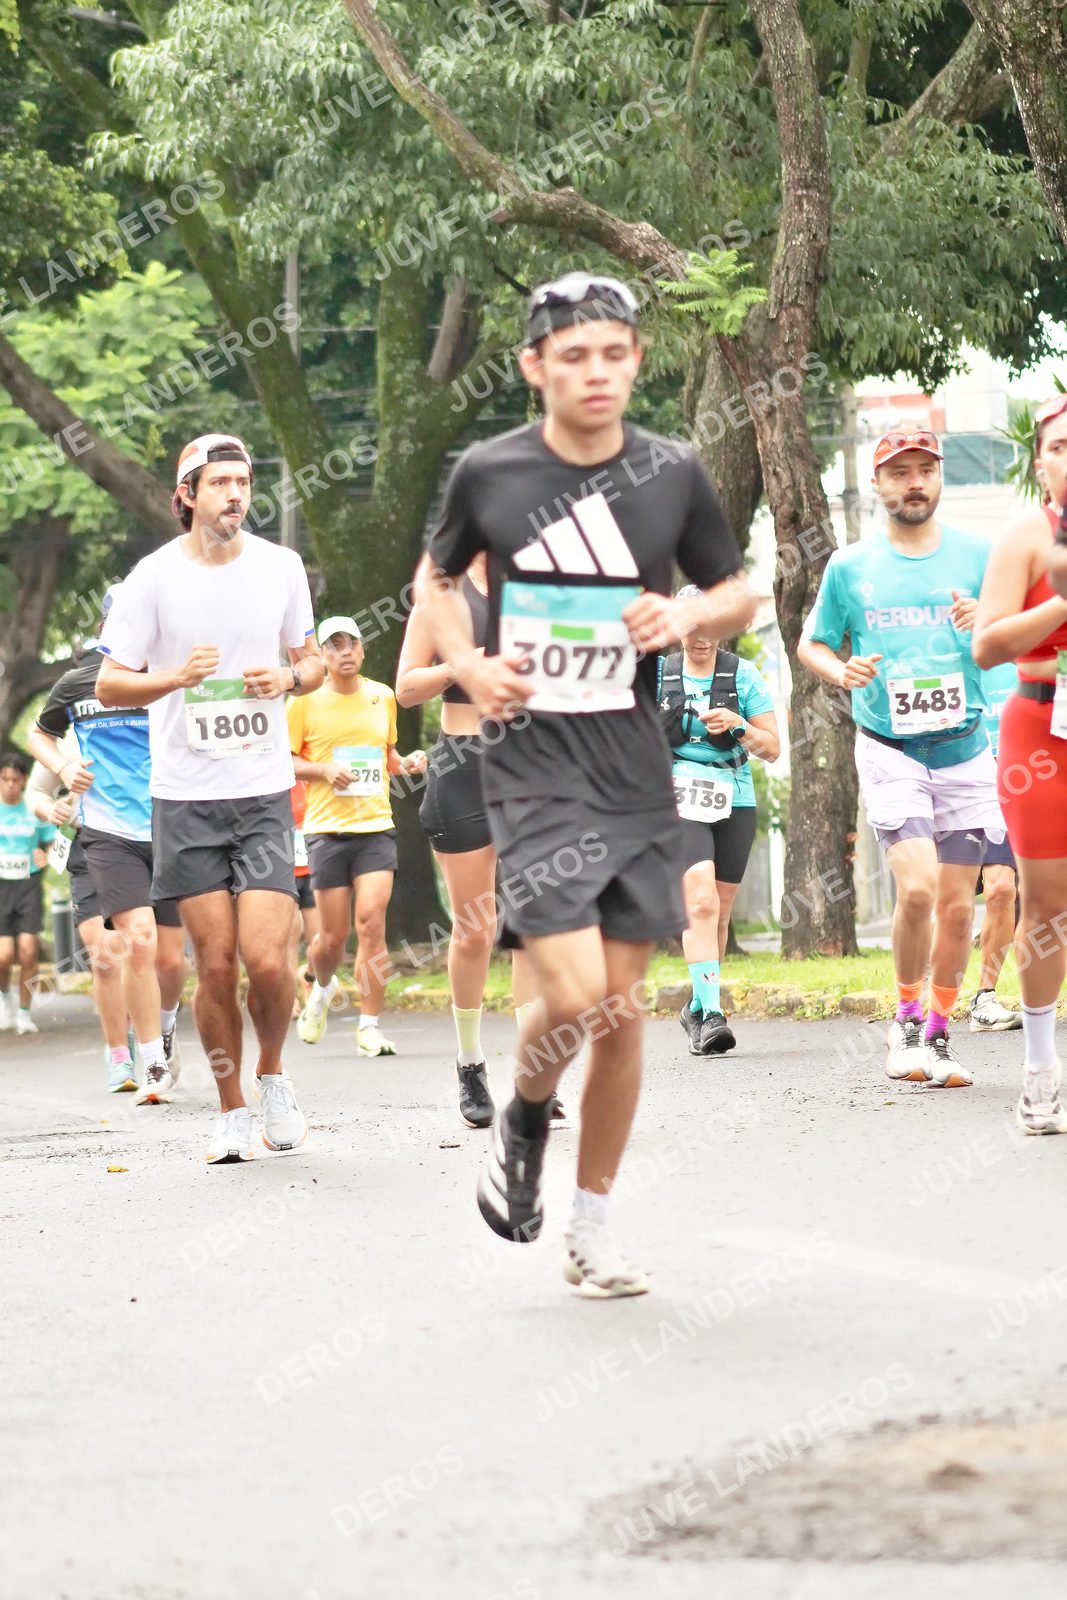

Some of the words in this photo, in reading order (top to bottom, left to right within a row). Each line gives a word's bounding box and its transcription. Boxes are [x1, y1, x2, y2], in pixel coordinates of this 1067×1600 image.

[513, 641, 627, 681] 3077
[894, 687, 962, 716] 3483
[195, 712, 269, 741] 1800
[673, 787, 728, 810] 3139
